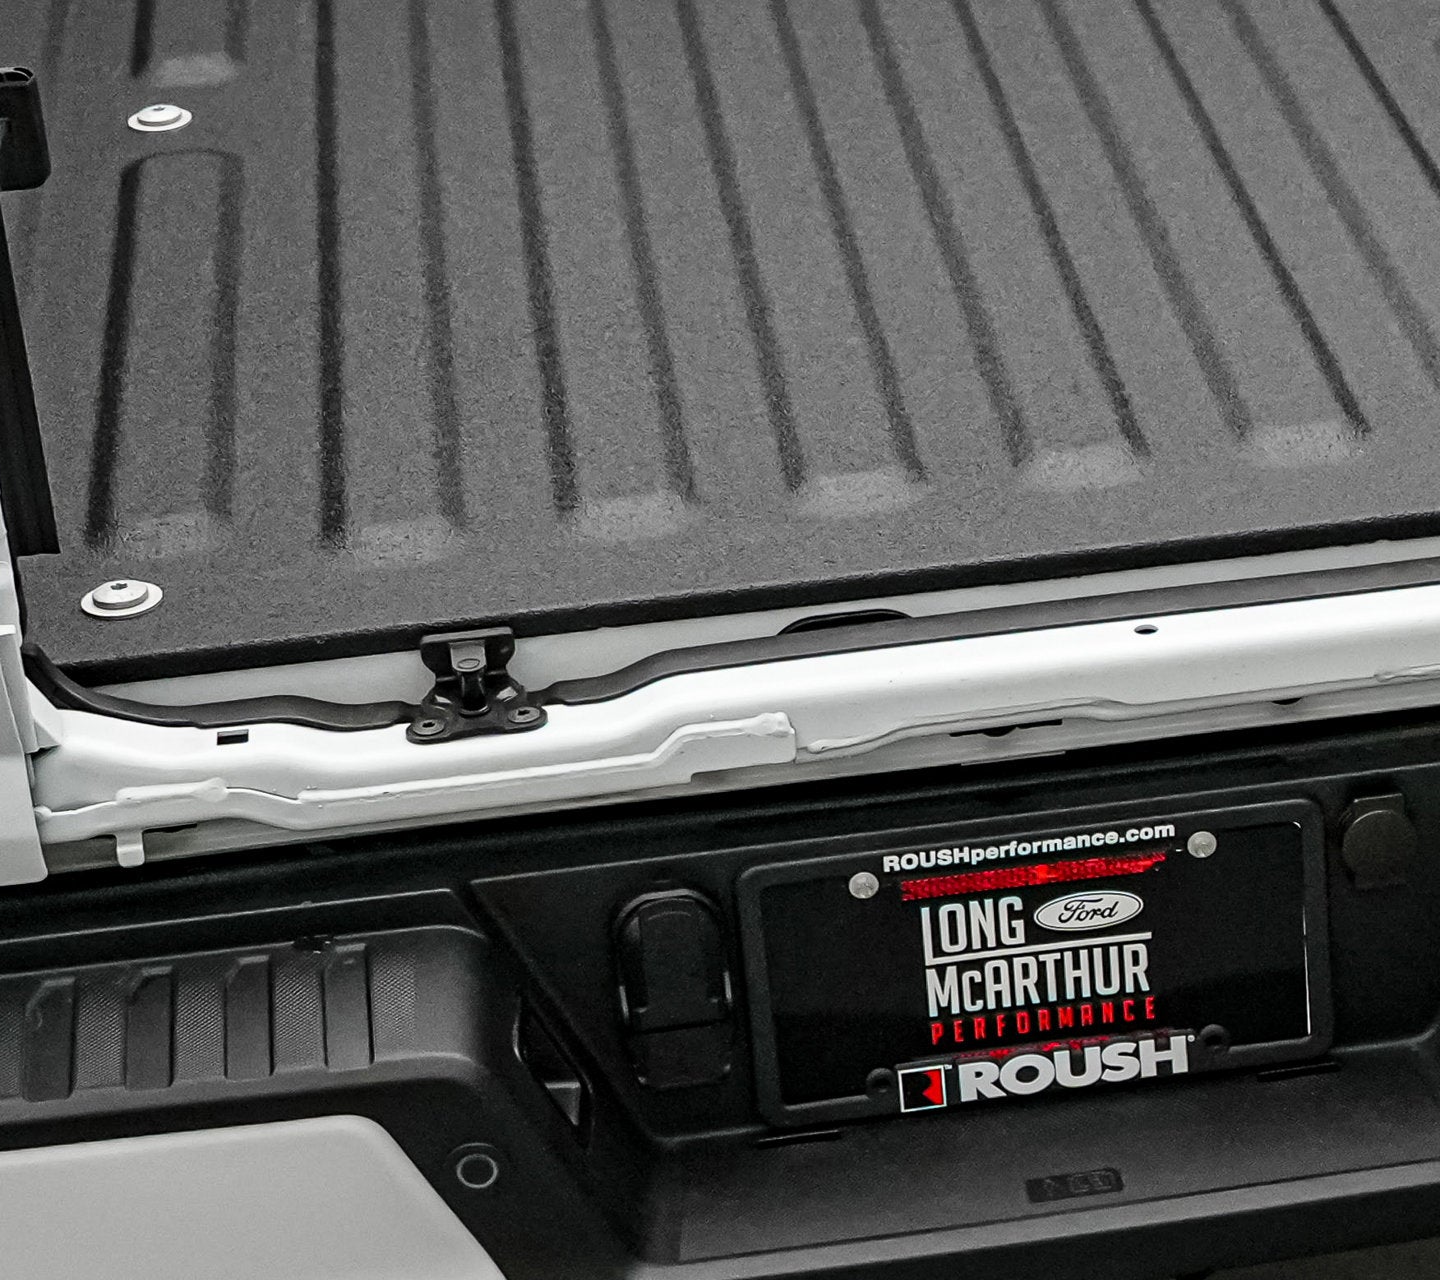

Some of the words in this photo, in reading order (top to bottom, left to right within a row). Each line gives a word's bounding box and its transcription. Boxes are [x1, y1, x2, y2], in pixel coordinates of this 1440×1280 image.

[882, 823, 1176, 873] ROUSHperformance.com
[920, 895, 1026, 966] LONG
[931, 995, 1156, 1046] PERFORMANCE
[959, 1035, 1190, 1103] ROUSH
